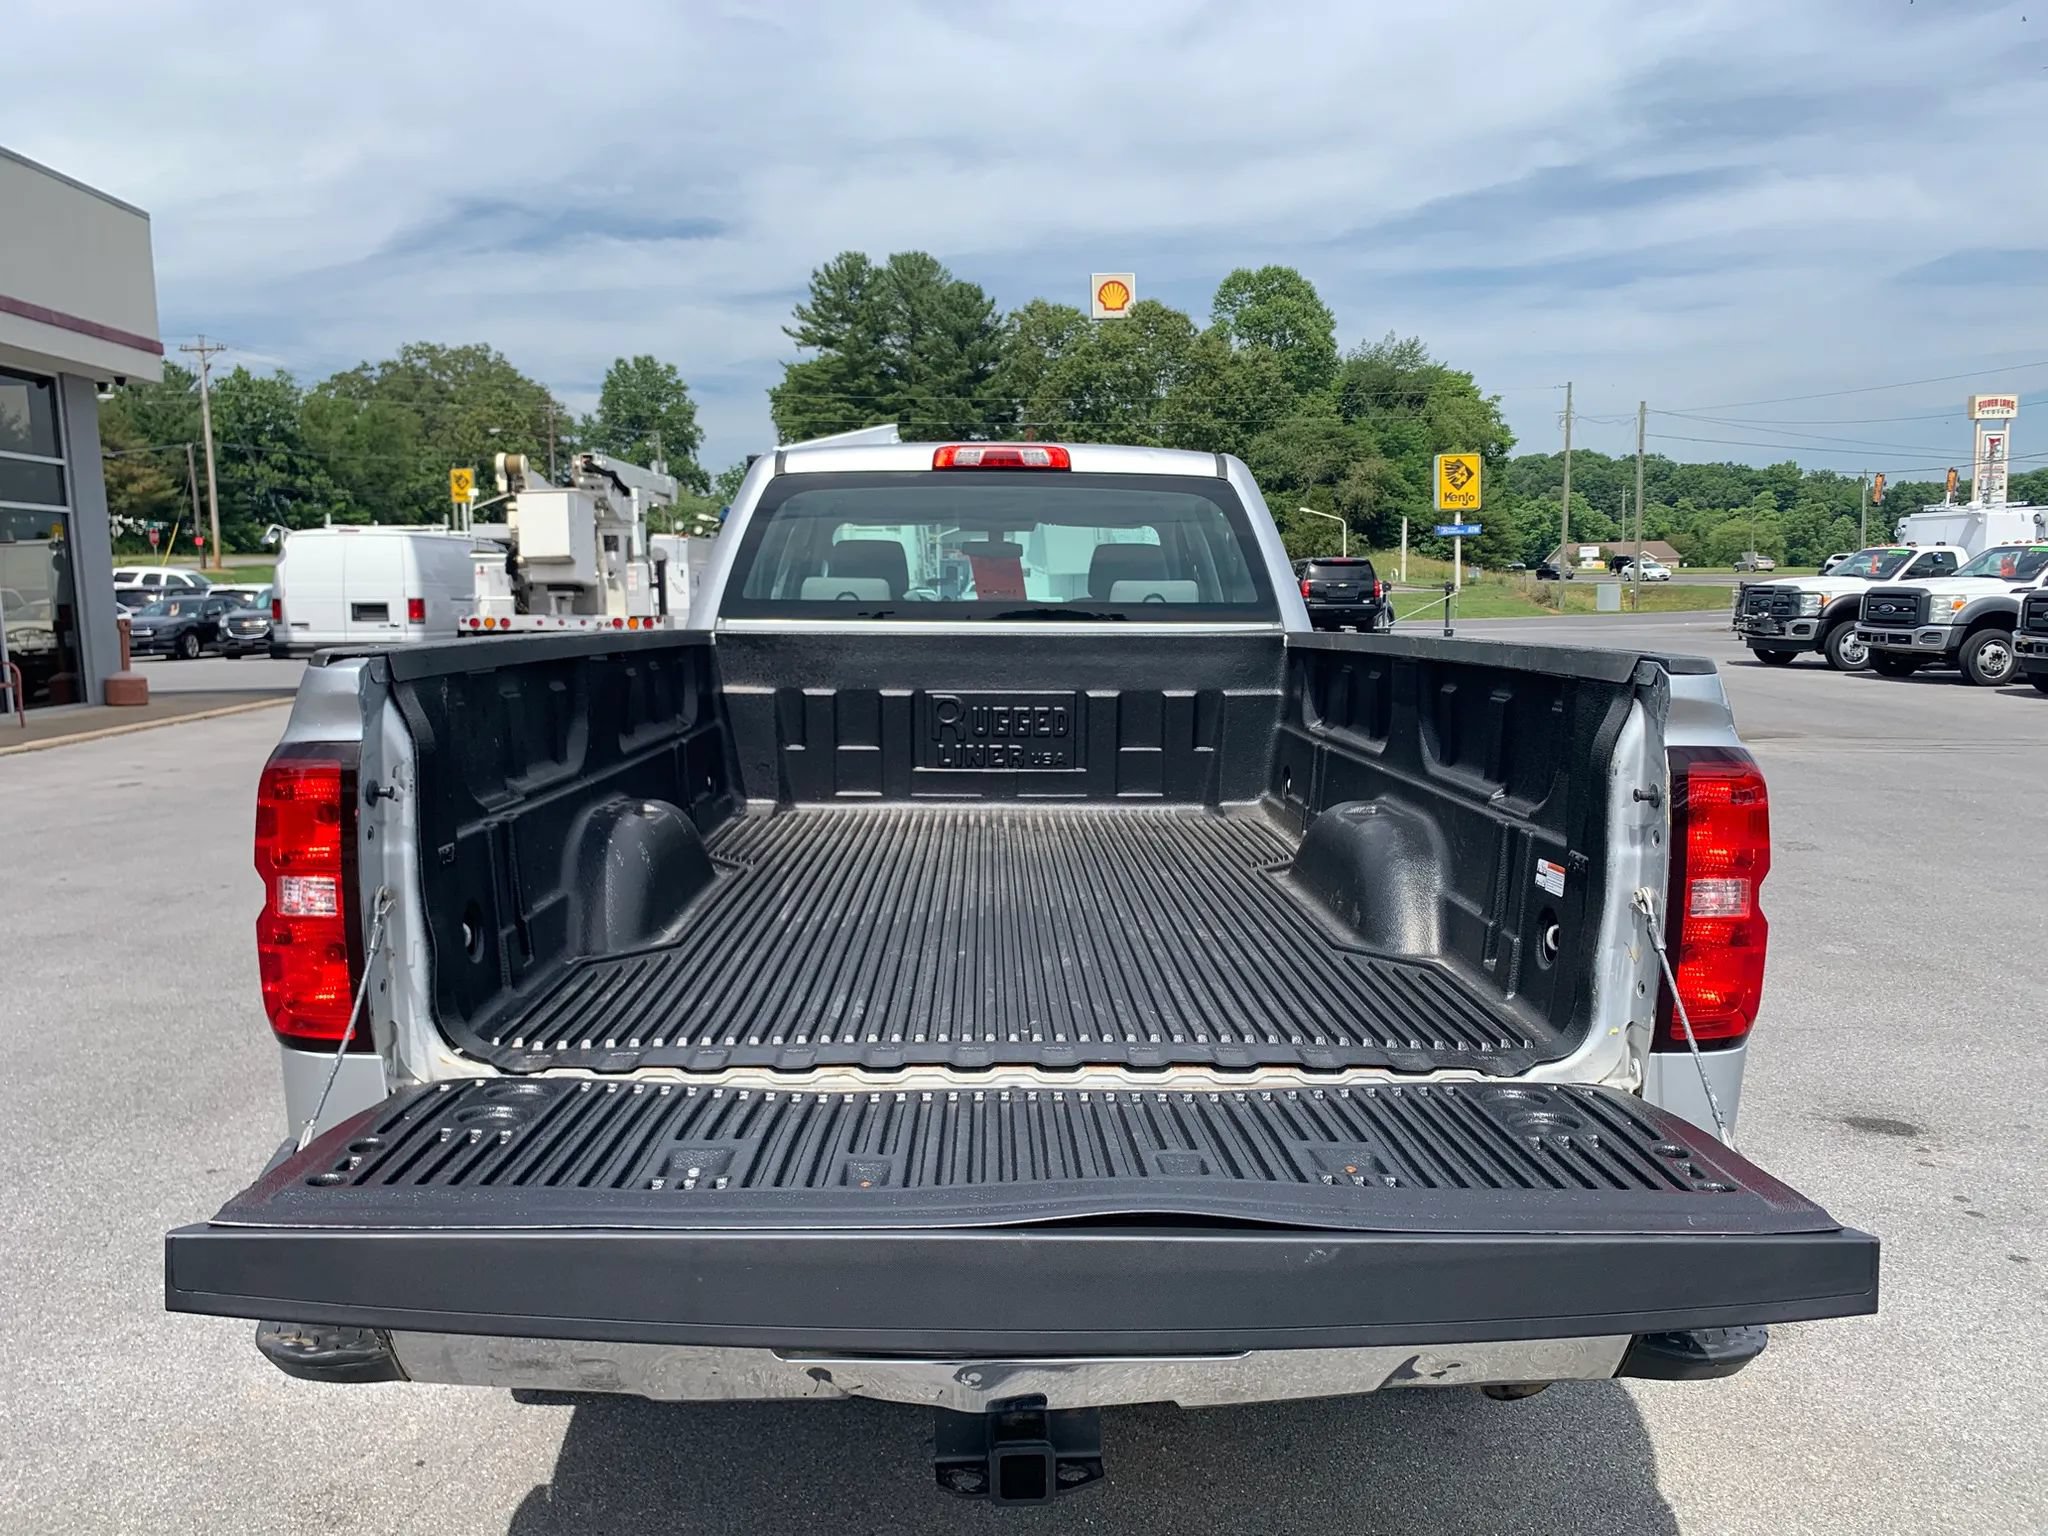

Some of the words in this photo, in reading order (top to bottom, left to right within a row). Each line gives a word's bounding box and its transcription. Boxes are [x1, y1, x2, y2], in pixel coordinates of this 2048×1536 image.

[1978, 399, 1998, 410] SILVER
[2000, 399, 2015, 410] LAKE
[1444, 492, 1475, 506] Kenjo
[931, 694, 1070, 742] RUGGED
[937, 744, 1025, 768] LINER
[1031, 752, 1067, 766] USA
